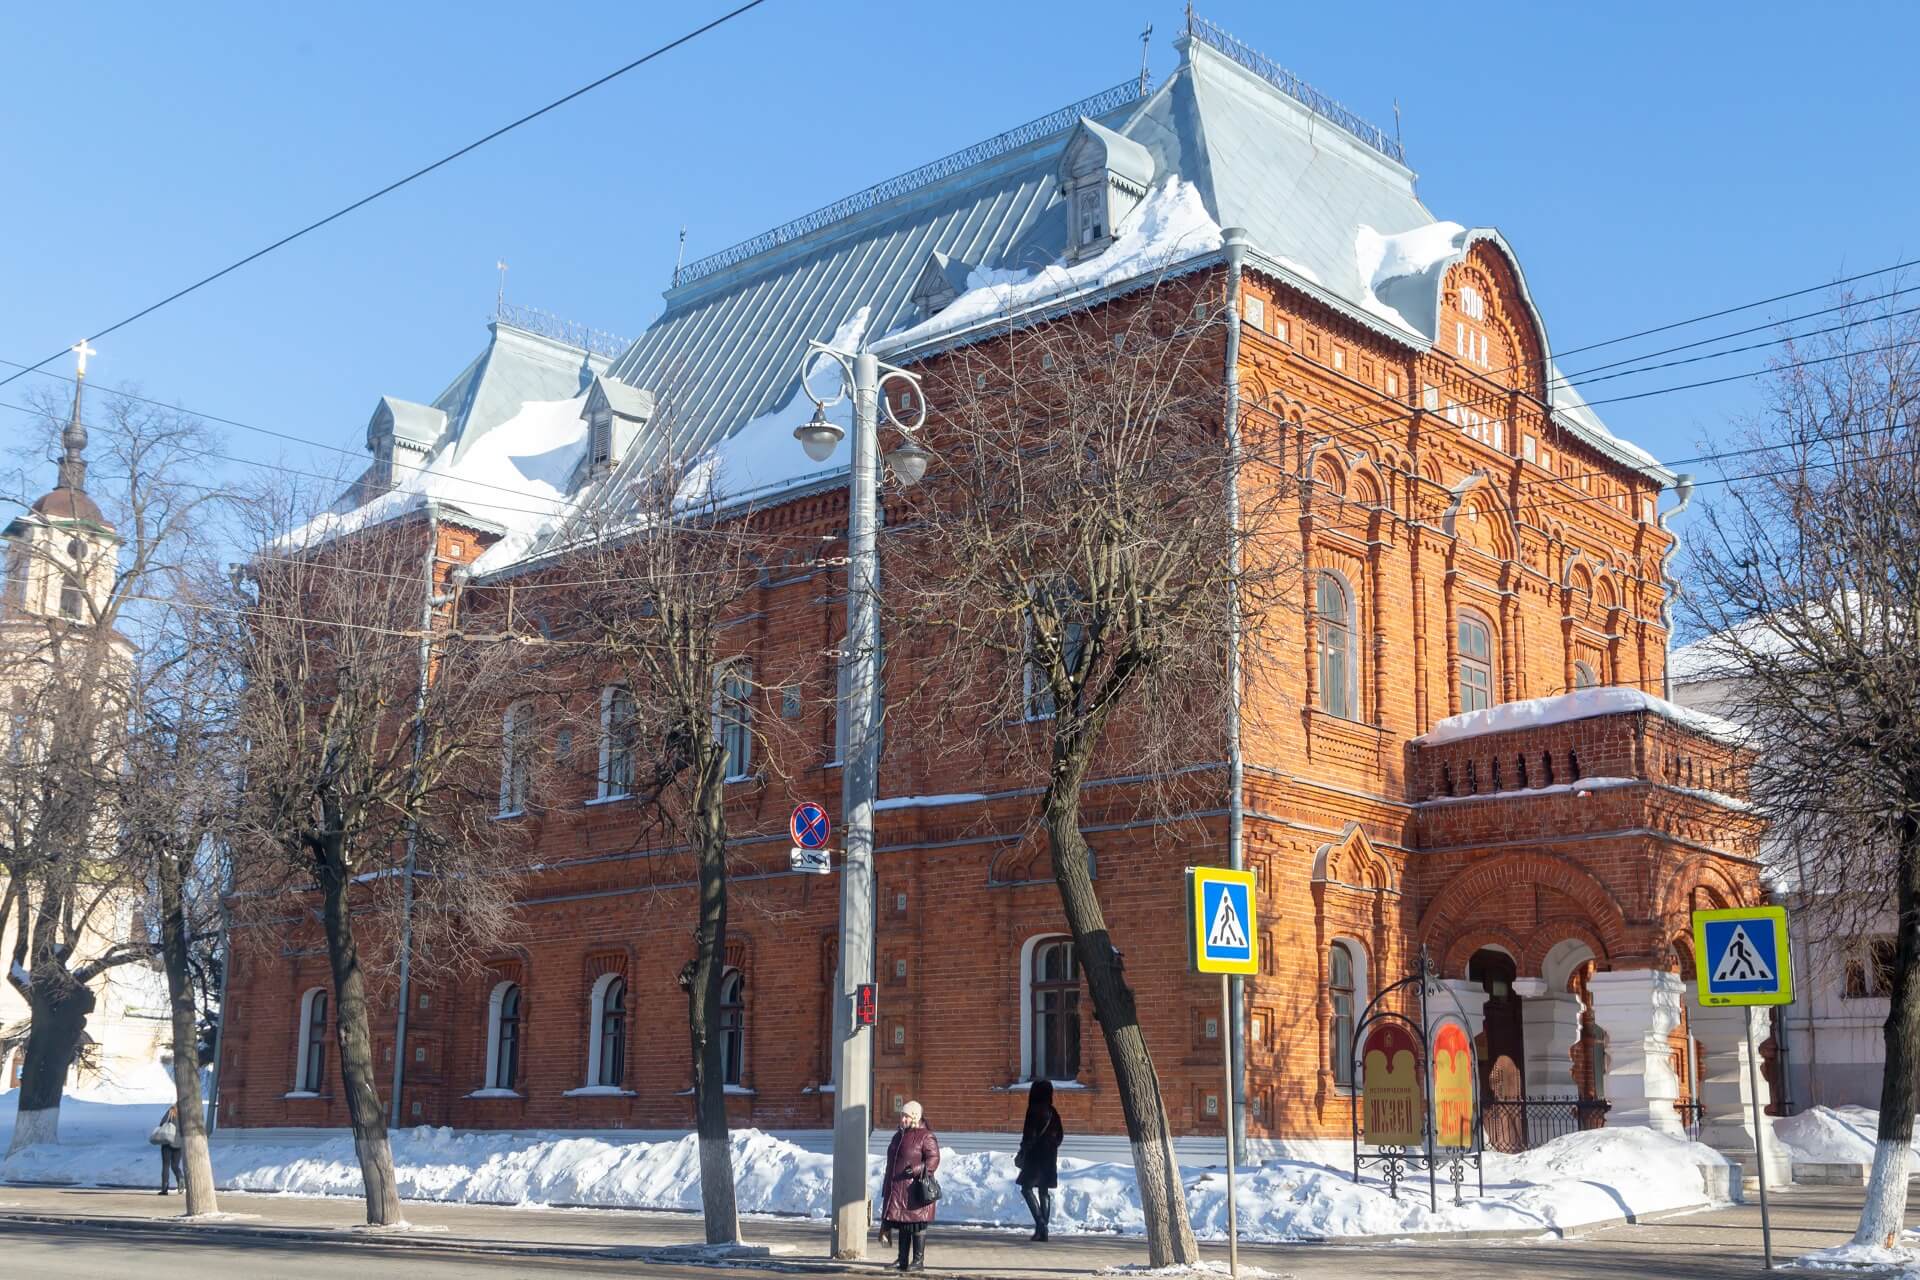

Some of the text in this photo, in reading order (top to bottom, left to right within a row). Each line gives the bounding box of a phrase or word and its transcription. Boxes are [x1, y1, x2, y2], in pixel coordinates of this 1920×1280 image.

[1459, 286, 1484, 321] 1900
[1456, 322, 1493, 370] В.А.К.
[1446, 399, 1502, 451] МУЗЕЙ
[1370, 1096, 1413, 1134] МУЗЕЙ
